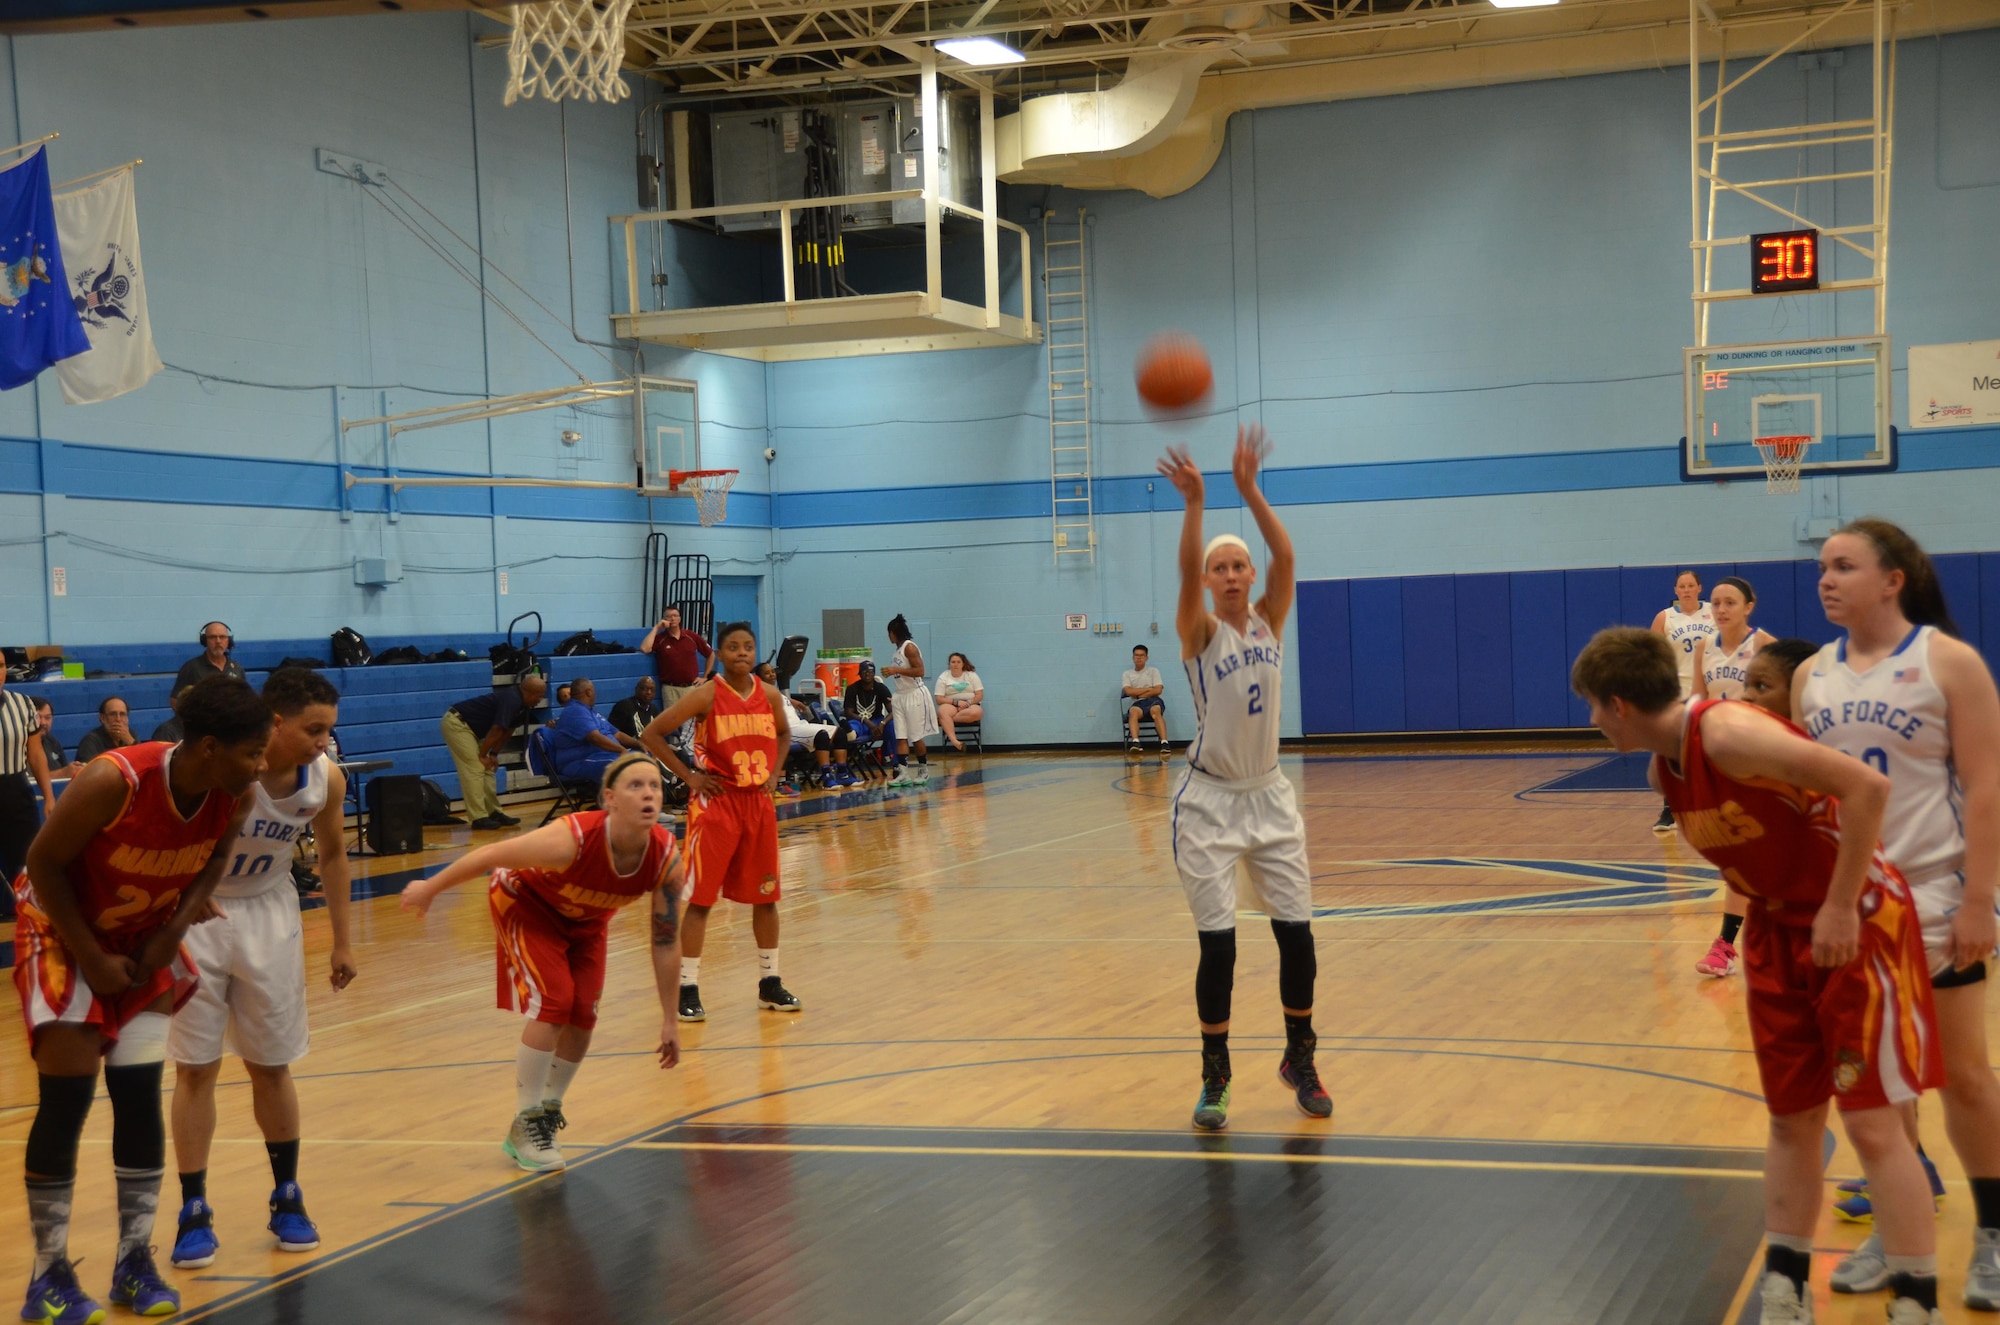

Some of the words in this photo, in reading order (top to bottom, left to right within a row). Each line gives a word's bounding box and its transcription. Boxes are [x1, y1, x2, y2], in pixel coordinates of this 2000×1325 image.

[1761, 237, 1813, 281] 30
[1732, 351, 1767, 360] DUNKING
[1771, 349, 1782, 357] OR
[1785, 347, 1822, 357] HANGING
[1825, 345, 1837, 353] ON
[1941, 408, 1972, 416] SPORTS
[1671, 627, 1685, 640] AIR
[1687, 624, 1714, 635] FORCE
[1214, 654, 1240, 681] AIR
[1716, 666, 1747, 682] FORC
[1248, 683, 1263, 716] 2
[1842, 700, 1923, 741] FORCE
[732, 750, 770, 787] 33
[108, 838, 218, 877] MARINE
